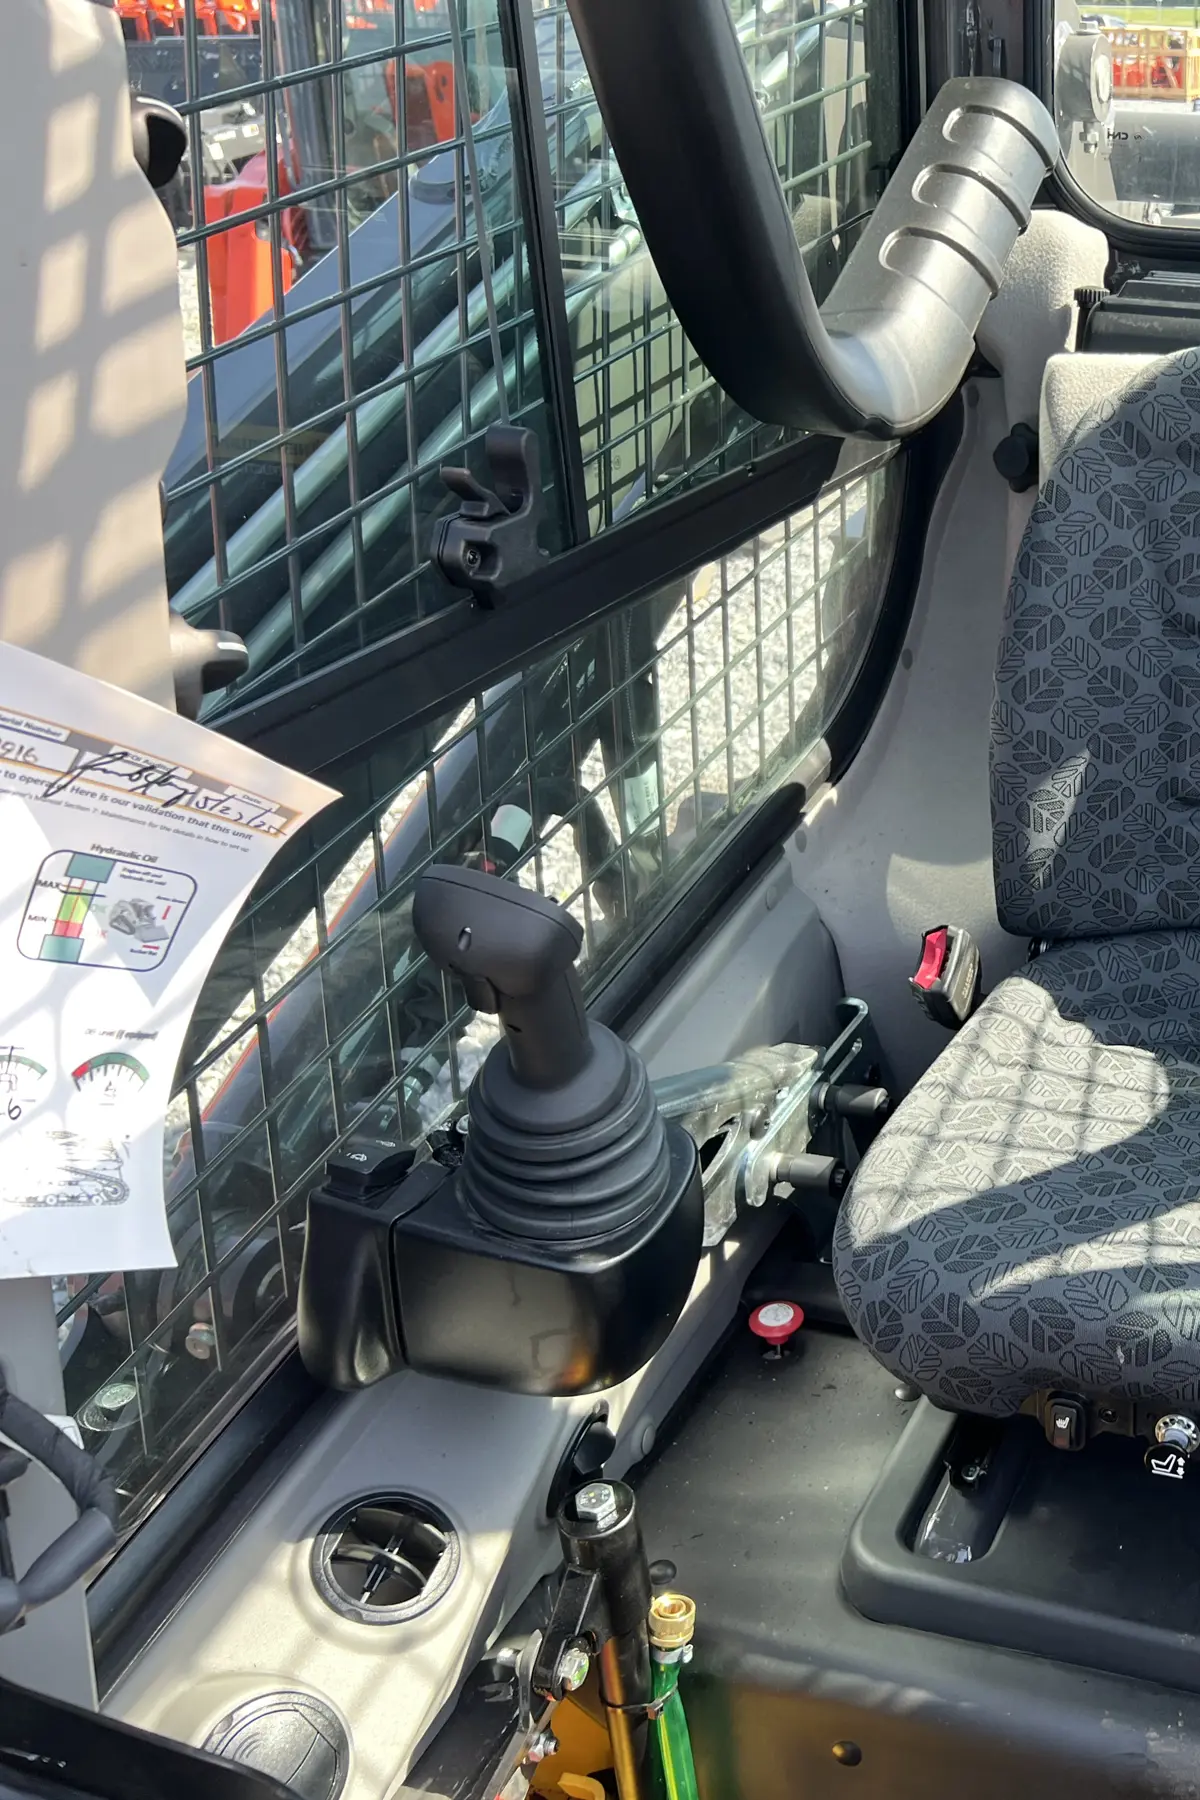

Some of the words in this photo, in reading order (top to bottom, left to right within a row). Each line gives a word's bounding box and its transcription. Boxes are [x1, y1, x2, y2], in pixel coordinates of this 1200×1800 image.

[23, 722, 63, 738] Number
[0, 737, 38, 763] 916
[4, 769, 17, 780] to
[70, 785, 98, 799] Here
[99, 792, 109, 801] is
[110, 796, 132, 807] our
[132, 803, 185, 821] validation
[187, 817, 210, 828] that
[211, 823, 231, 834] this
[232, 831, 253, 840] unit
[242, 794, 262, 805] Date
[64, 800, 90, 812] Section
[148, 821, 159, 829] for
[160, 824, 171, 832] the
[172, 828, 196, 839] details
[204, 836, 220, 845] how
[229, 842, 240, 851] set
[90, 843, 141, 861] Hydraulic
[142, 854, 159, 864] Oil
[35, 879, 62, 890] MAX
